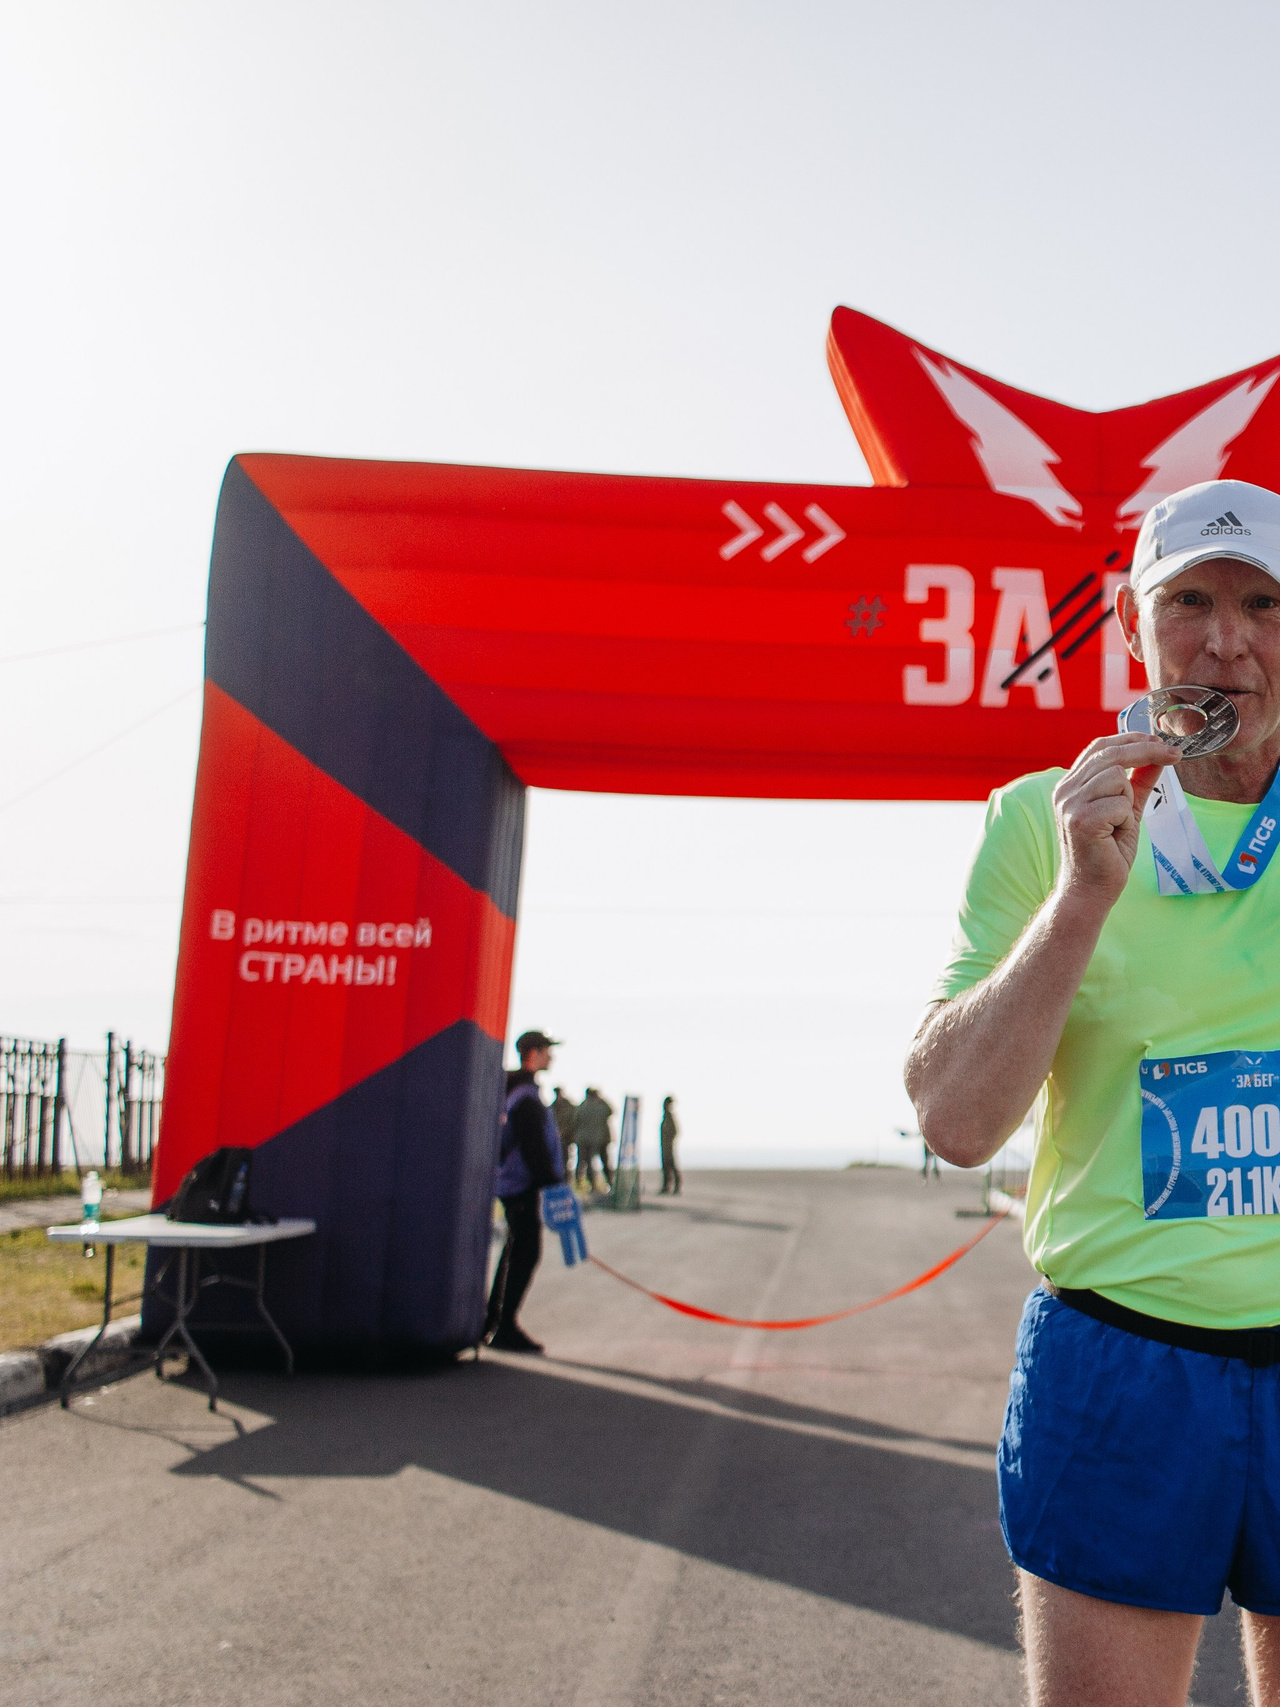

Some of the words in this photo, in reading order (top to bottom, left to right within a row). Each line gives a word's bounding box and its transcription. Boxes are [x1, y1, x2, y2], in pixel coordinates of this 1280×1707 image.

[1200, 526, 1252, 536] adidas
[1248, 816, 1277, 854] ПСБ
[210, 909, 236, 941] В
[243, 917, 349, 947] ритме
[356, 916, 433, 949] всей
[239, 950, 398, 986] СТРАНЫ!
[1174, 1061, 1208, 1076] ПСБ
[1254, 1073, 1275, 1087] БЕГ
